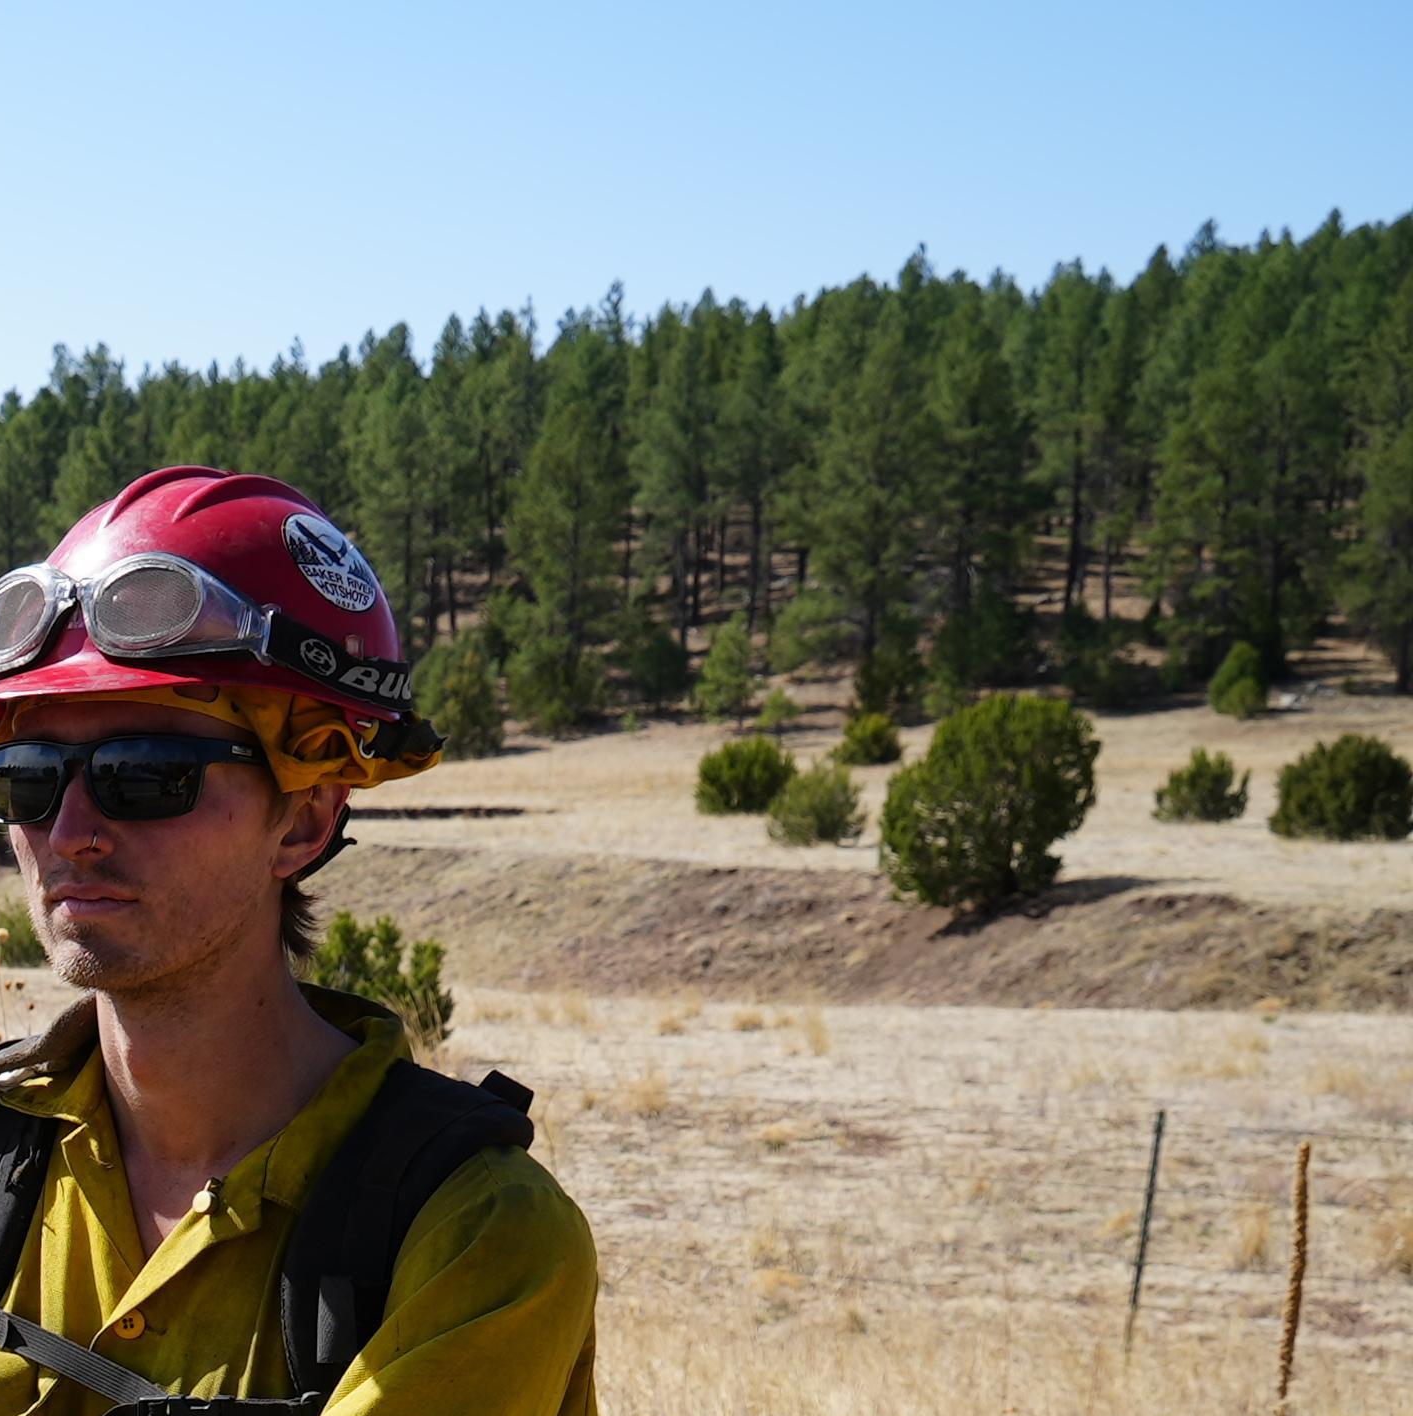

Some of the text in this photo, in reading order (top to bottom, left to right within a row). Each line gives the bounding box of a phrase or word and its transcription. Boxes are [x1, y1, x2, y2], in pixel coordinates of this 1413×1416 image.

[302, 565, 374, 597] BAKER RIVER
[315, 579, 370, 606] HOTSHOTS
